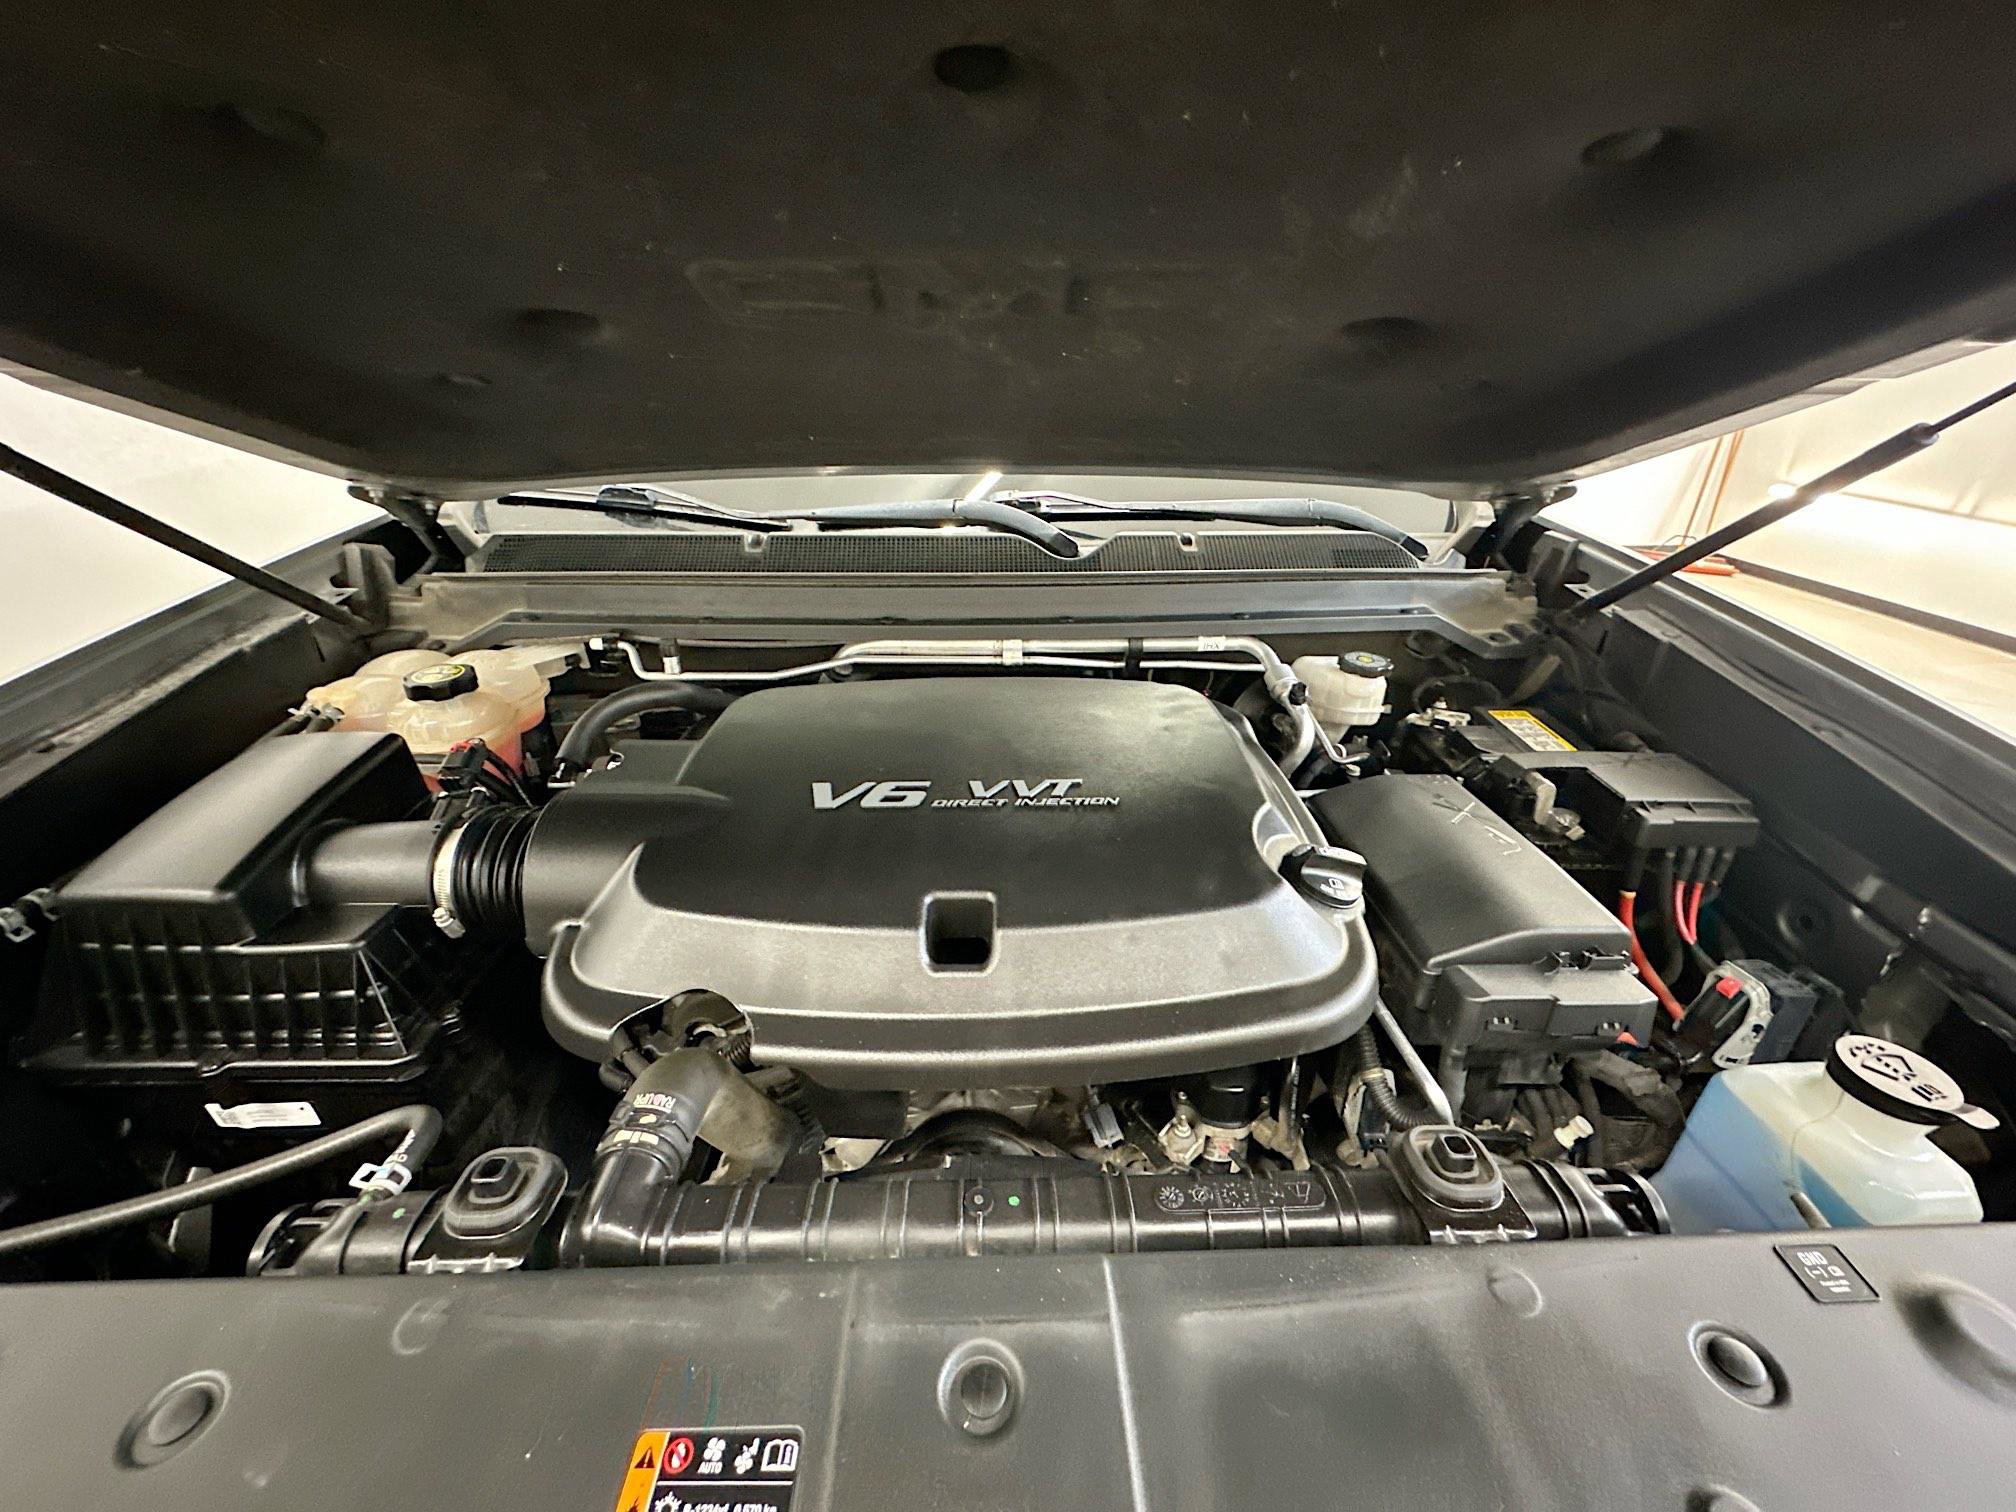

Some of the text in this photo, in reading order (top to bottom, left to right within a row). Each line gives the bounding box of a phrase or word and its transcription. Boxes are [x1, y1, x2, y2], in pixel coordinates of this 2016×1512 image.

[811, 778, 1083, 809] V6 VVT
[930, 796, 1120, 808] DIRECT INJECTION
[1796, 1251, 1828, 1266] GND
[697, 1461, 723, 1474] AUTO
